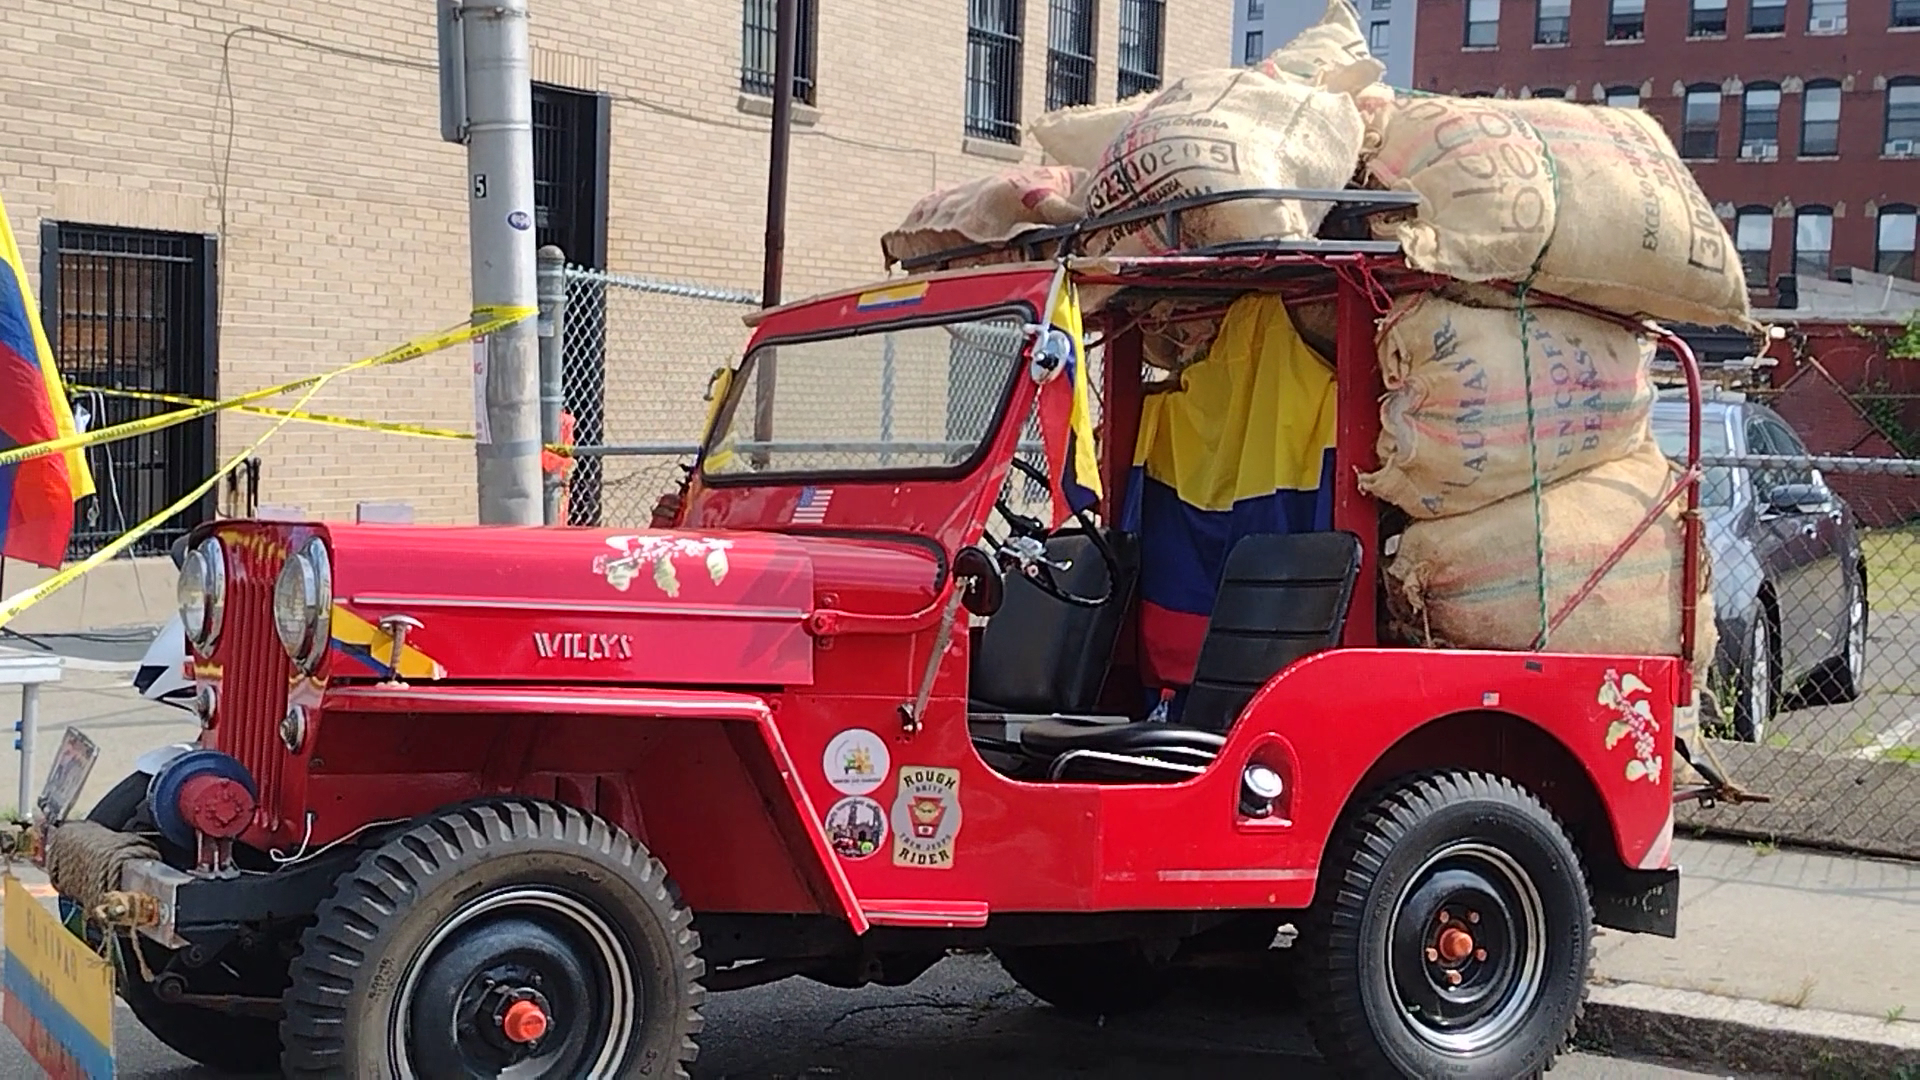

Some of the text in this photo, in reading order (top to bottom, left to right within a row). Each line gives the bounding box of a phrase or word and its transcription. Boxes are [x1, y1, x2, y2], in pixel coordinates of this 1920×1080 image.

[1141, 118, 1229, 133] COLOMBIA
[476, 174, 485, 198] 5
[533, 631, 634, 661] WILLYS
[903, 770, 956, 790] ROUGH
[898, 847, 950, 865] RIDER
